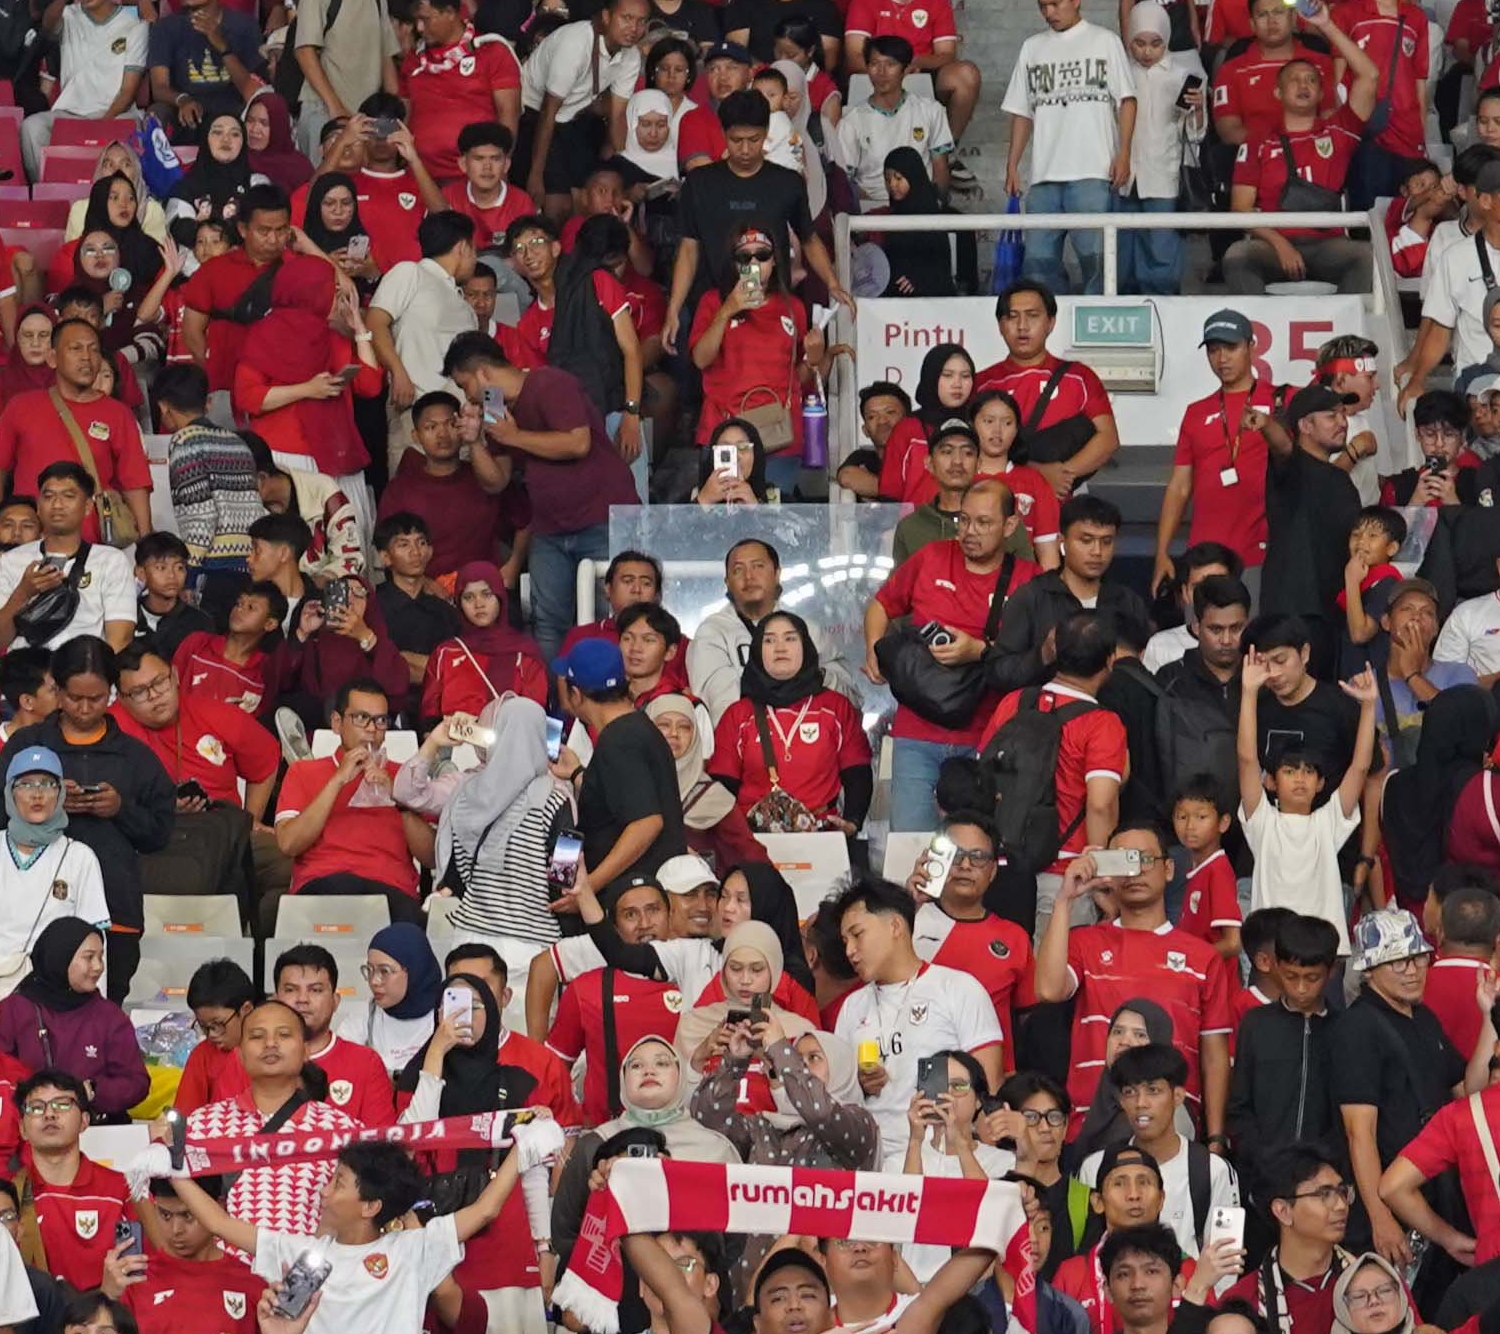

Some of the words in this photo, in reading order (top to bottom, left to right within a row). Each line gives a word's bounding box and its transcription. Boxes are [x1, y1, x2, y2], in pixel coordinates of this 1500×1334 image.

[884, 322, 965, 349] Pintu
[1088, 315, 1141, 335] EXIT
[730, 1183, 919, 1216] rumahsakit
